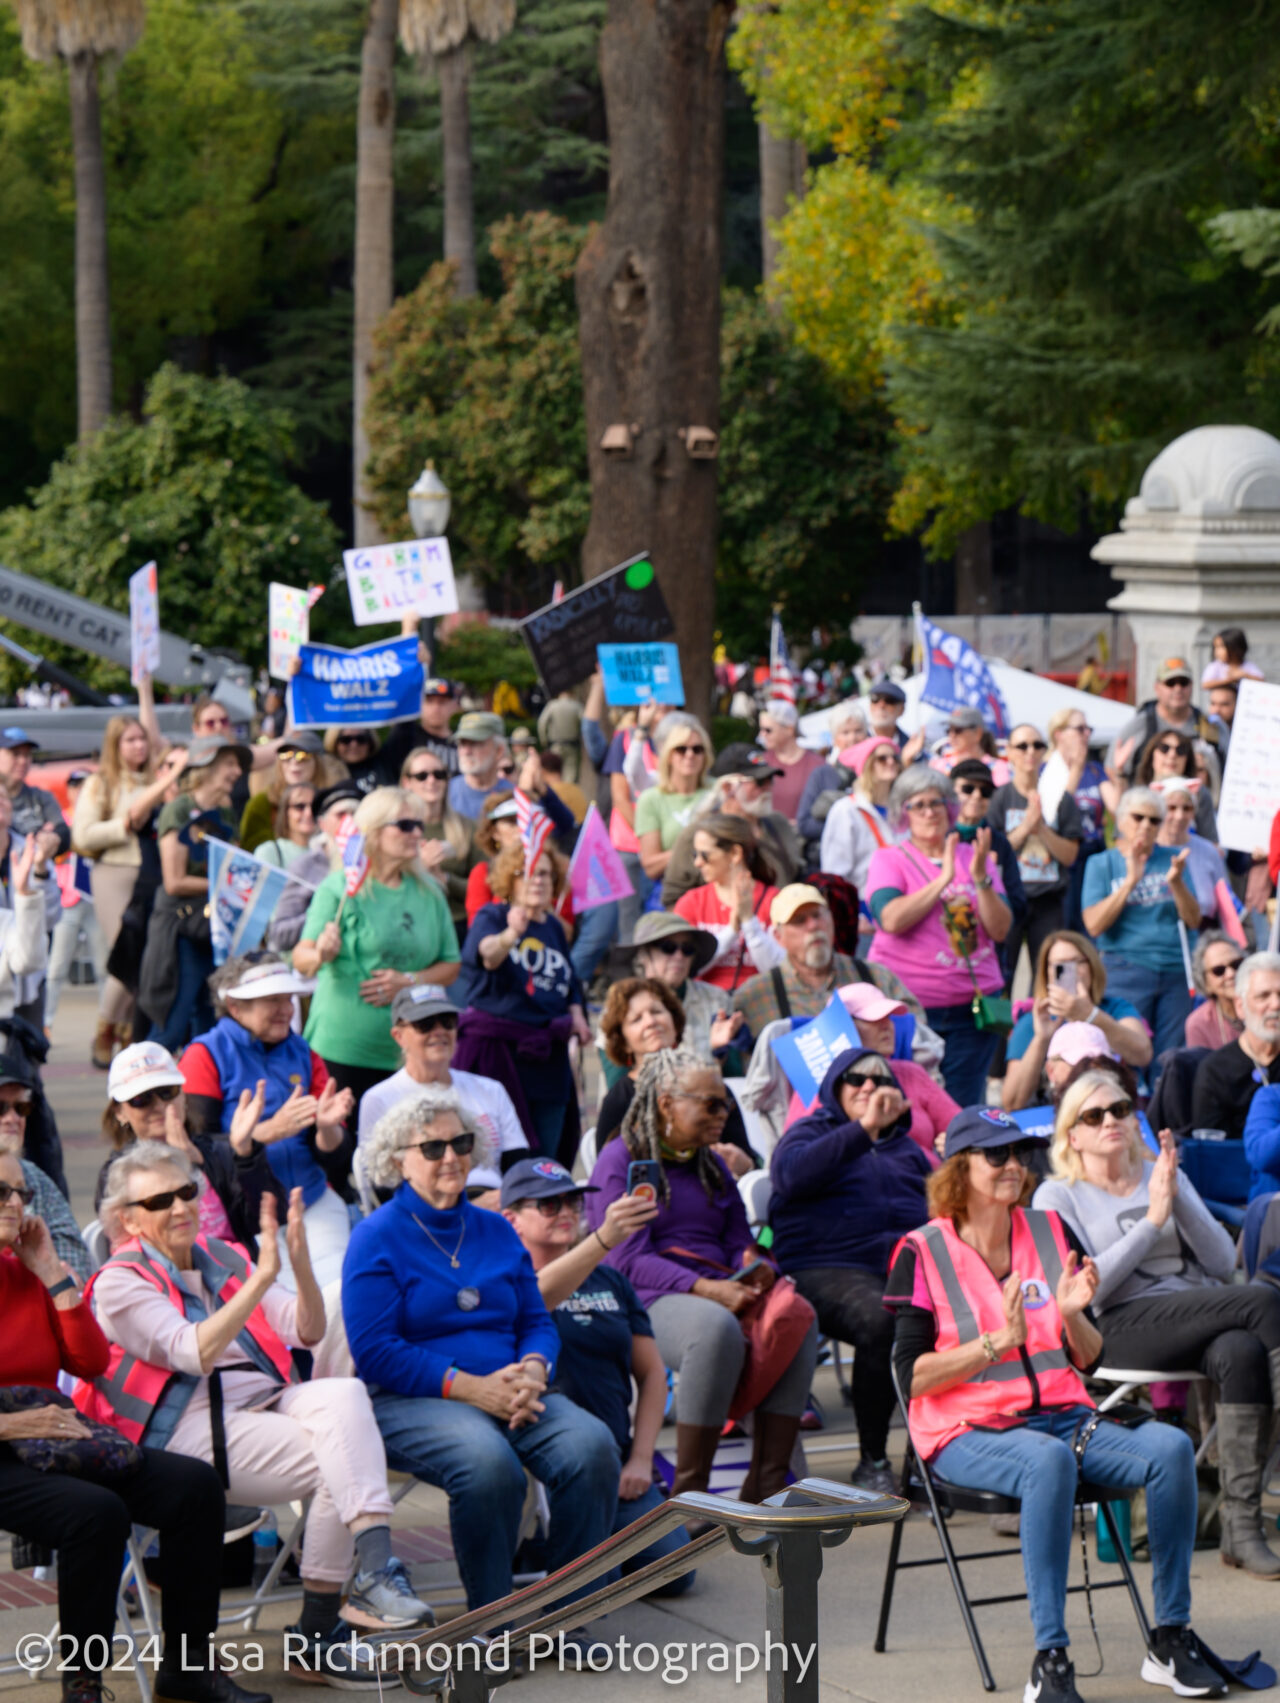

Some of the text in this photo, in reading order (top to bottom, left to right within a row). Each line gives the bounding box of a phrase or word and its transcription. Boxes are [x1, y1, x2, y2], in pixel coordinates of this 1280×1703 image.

[15, 592, 75, 629] RENT
[79, 618, 122, 646] CAT
[312, 649, 402, 683] HARRIS
[330, 679, 390, 700] WALZ
